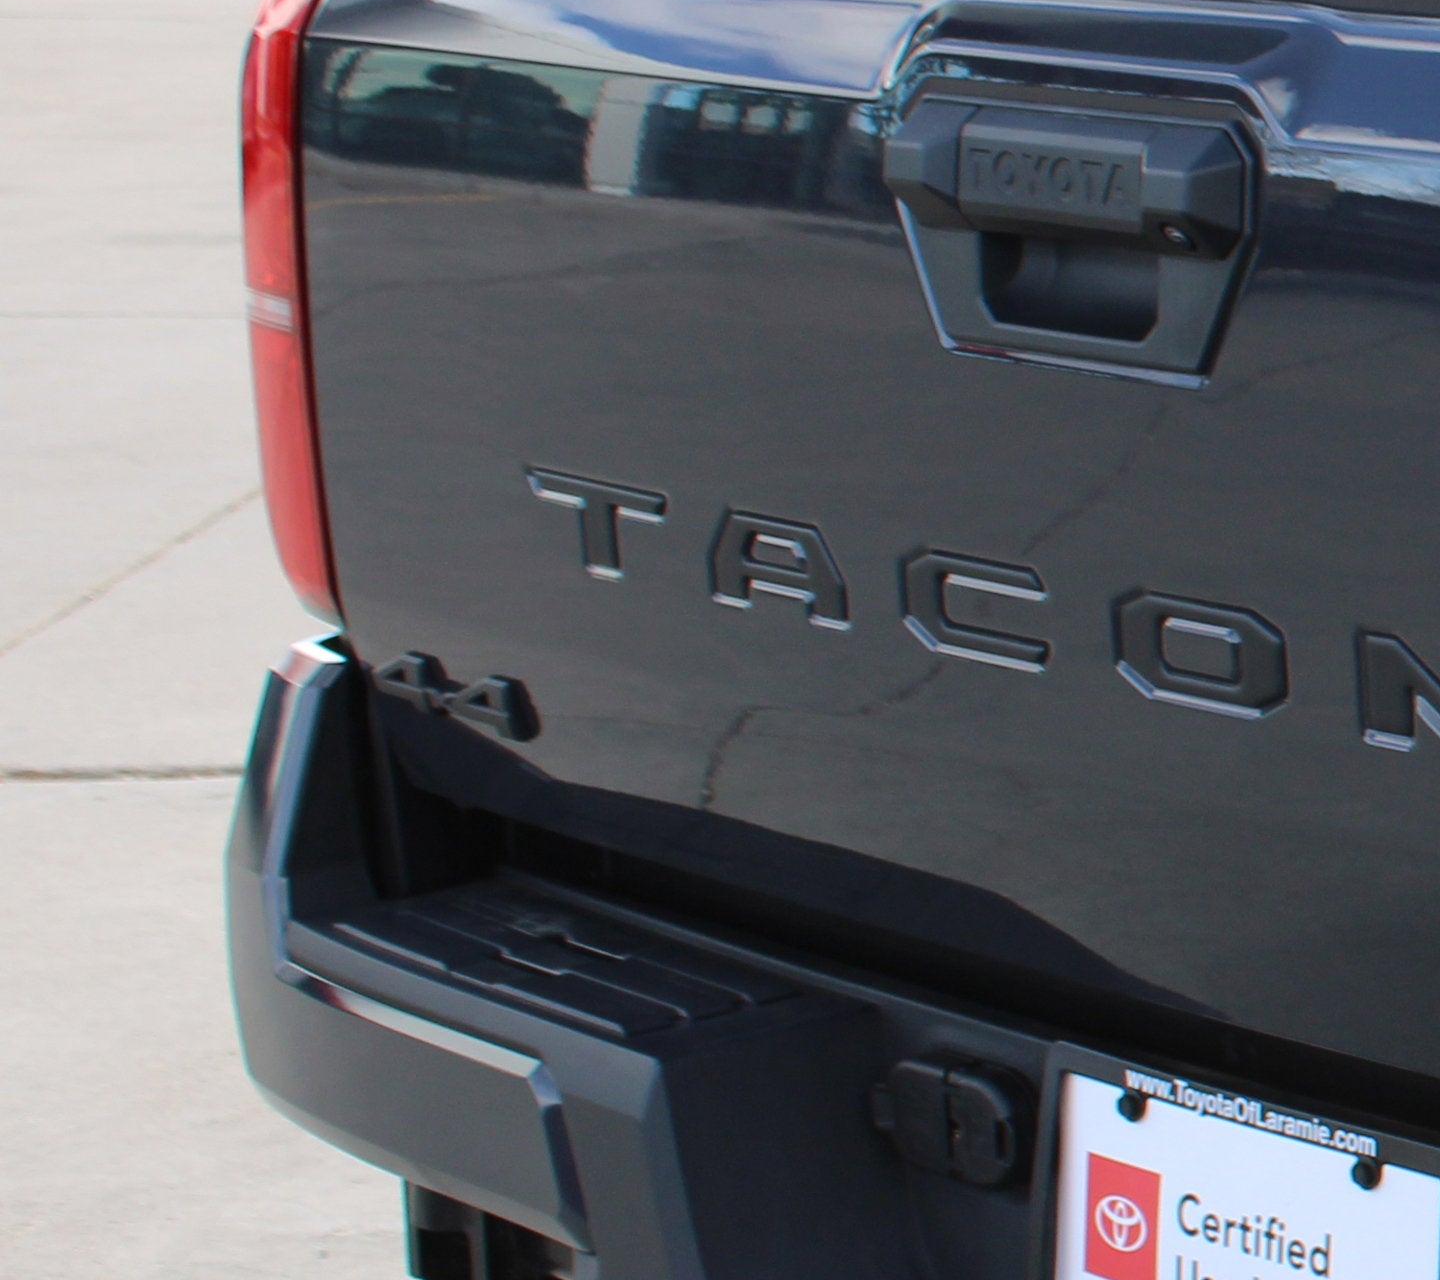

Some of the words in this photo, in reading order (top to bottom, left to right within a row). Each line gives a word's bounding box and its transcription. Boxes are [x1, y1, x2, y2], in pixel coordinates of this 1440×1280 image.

[968, 147, 1126, 204] TOYOTA
[1125, 1069, 1377, 1157] www.ToyotaOfLaramie.com
[1177, 1193, 1333, 1278] Certified
